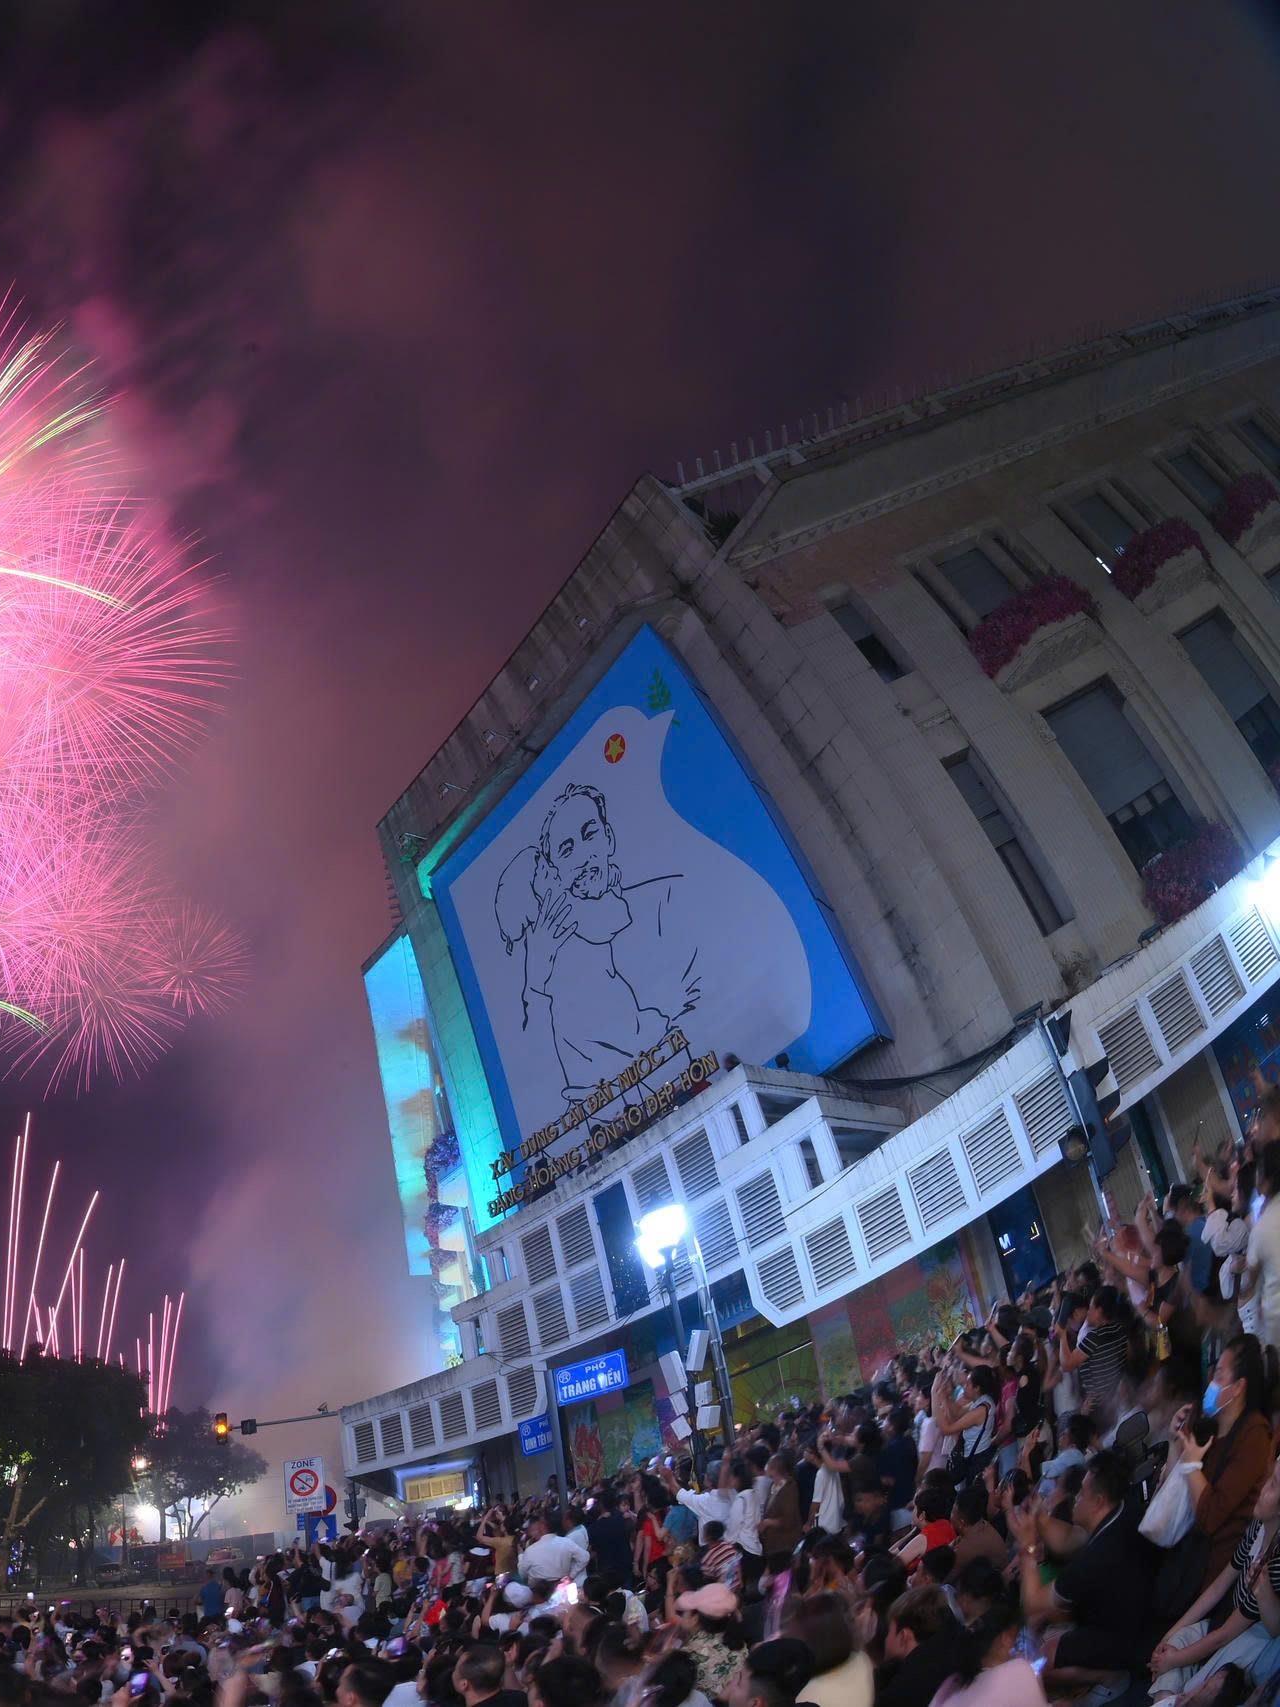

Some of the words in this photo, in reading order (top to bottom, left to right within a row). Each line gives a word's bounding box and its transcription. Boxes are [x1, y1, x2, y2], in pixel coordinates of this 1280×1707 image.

[664, 1029, 690, 1054] TA
[561, 1377, 597, 1399] TRÀNG
[291, 1460, 315, 1469] ZONE
